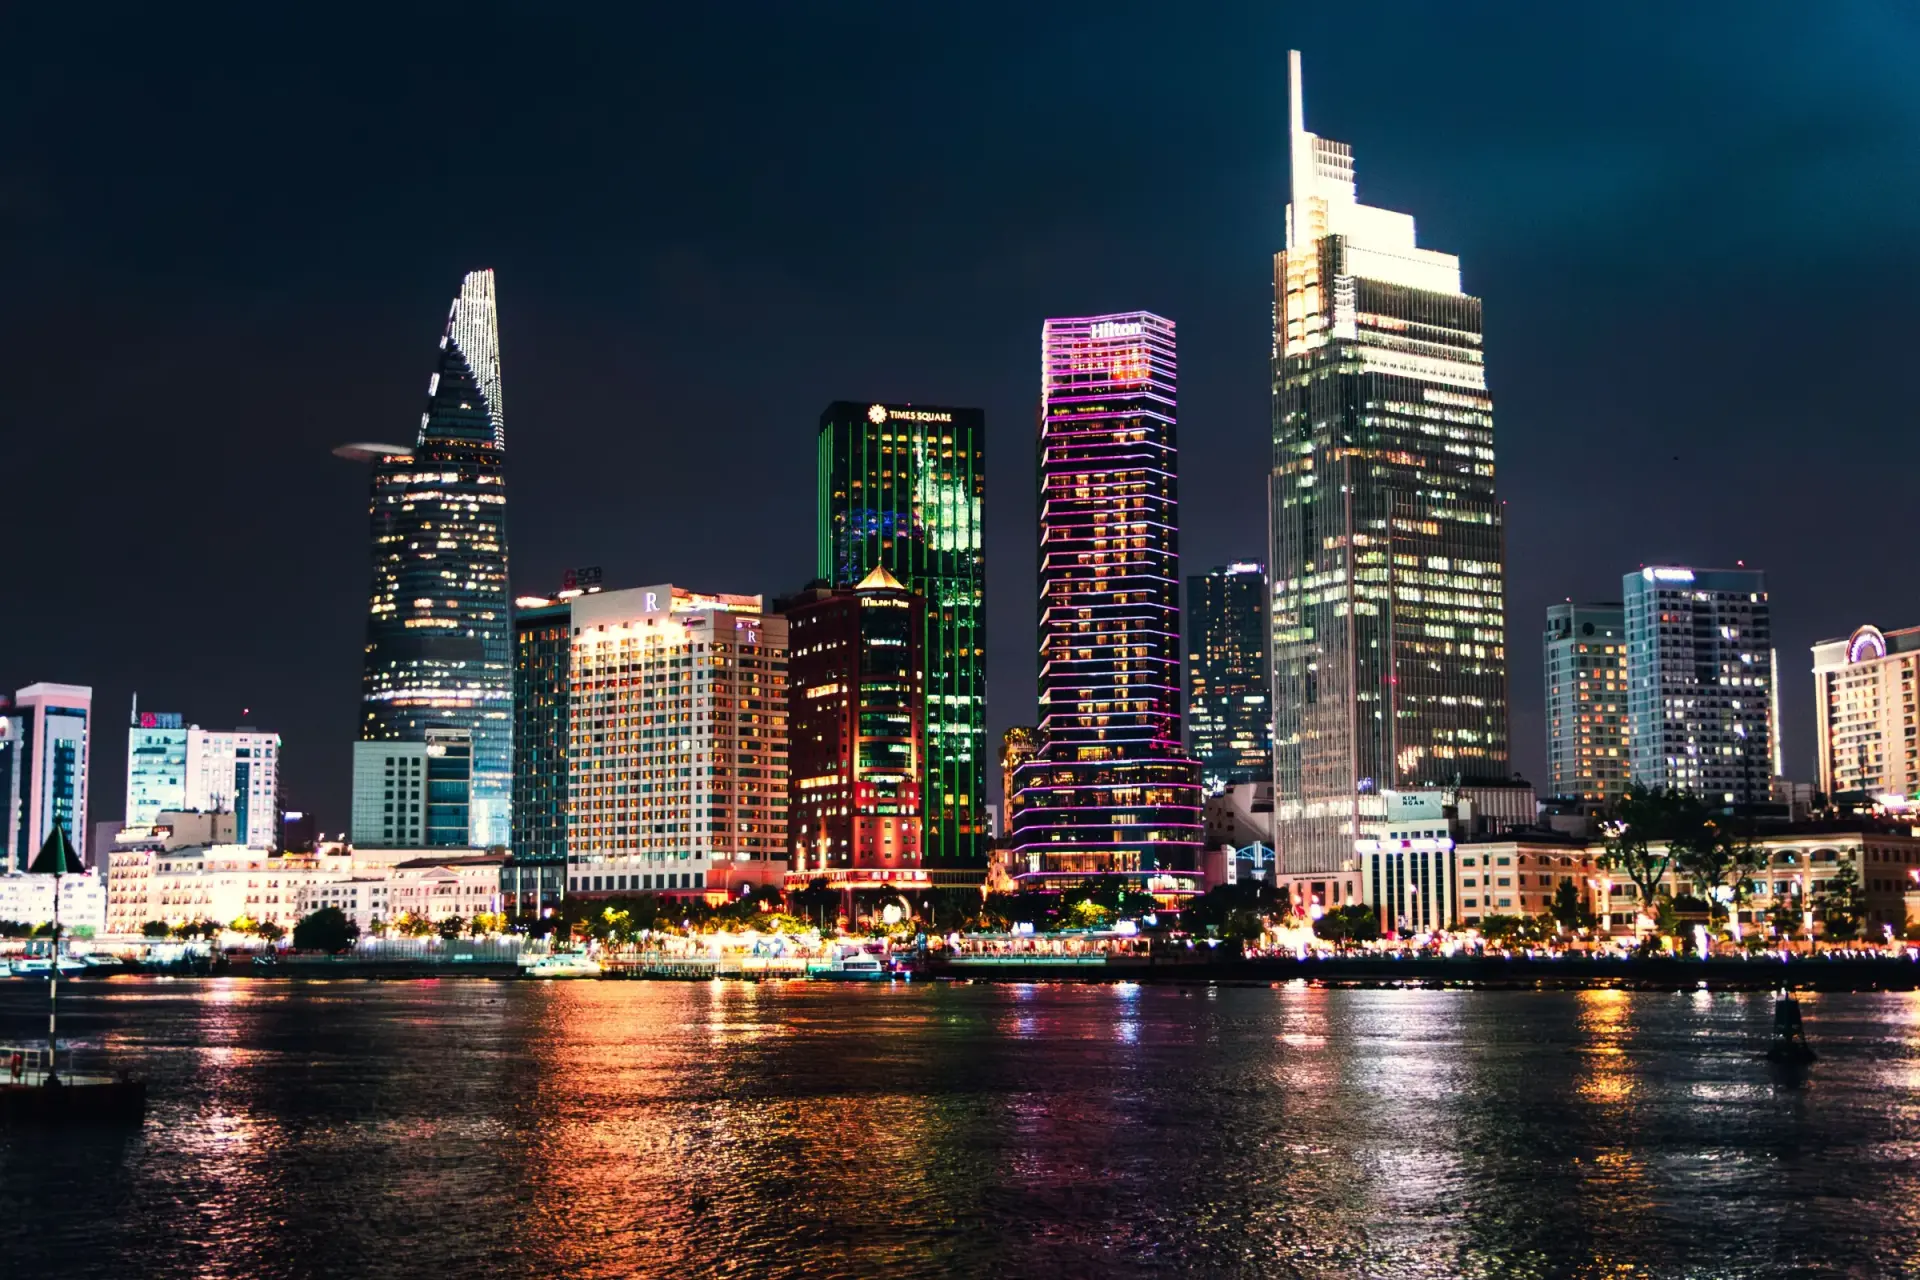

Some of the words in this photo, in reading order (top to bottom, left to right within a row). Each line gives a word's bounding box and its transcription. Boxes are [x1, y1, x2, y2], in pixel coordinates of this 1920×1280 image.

[1091, 322, 1141, 339] Hilton
[889, 410, 916, 420] TIMES
[916, 412, 952, 422] SQUARE
[645, 592, 660, 612] R
[748, 630, 756, 643] R
[743, 884, 750, 894] R
